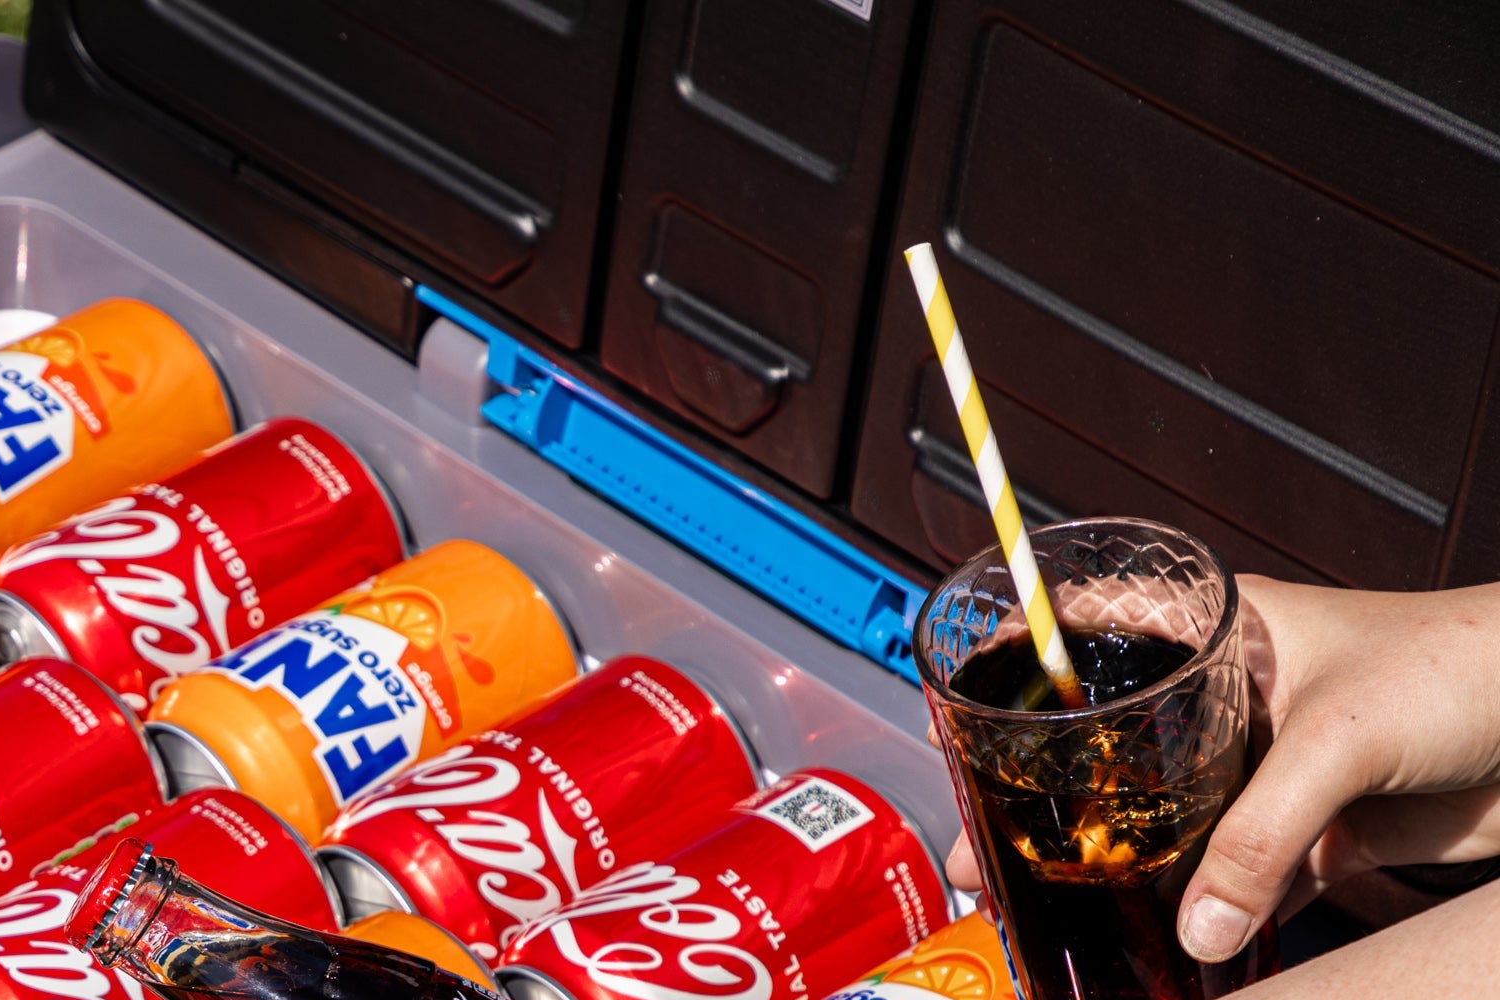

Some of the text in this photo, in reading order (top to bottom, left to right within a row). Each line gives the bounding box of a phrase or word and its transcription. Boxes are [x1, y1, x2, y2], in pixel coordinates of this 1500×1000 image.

[1, 369, 63, 417] zero
[49, 374, 102, 433] orange
[289, 445, 343, 503] Delicious
[291, 433, 353, 496] Refreshing
[186, 503, 266, 630] ORIGINAL
[33, 679, 89, 736] Delicious
[35, 670, 100, 729] Refreshing
[356, 649, 419, 716] zero
[406, 661, 453, 731] orange
[631, 670, 699, 730] Refreshing
[631, 682, 688, 737] Delicious
[198, 806, 259, 857] Delicious
[203, 797, 269, 851] Refreshing
[527, 746, 616, 870] ORIGINAL
[717, 869, 787, 951] TASTE
[892, 882, 918, 944] elicious
[896, 862, 930, 938] efreshing
